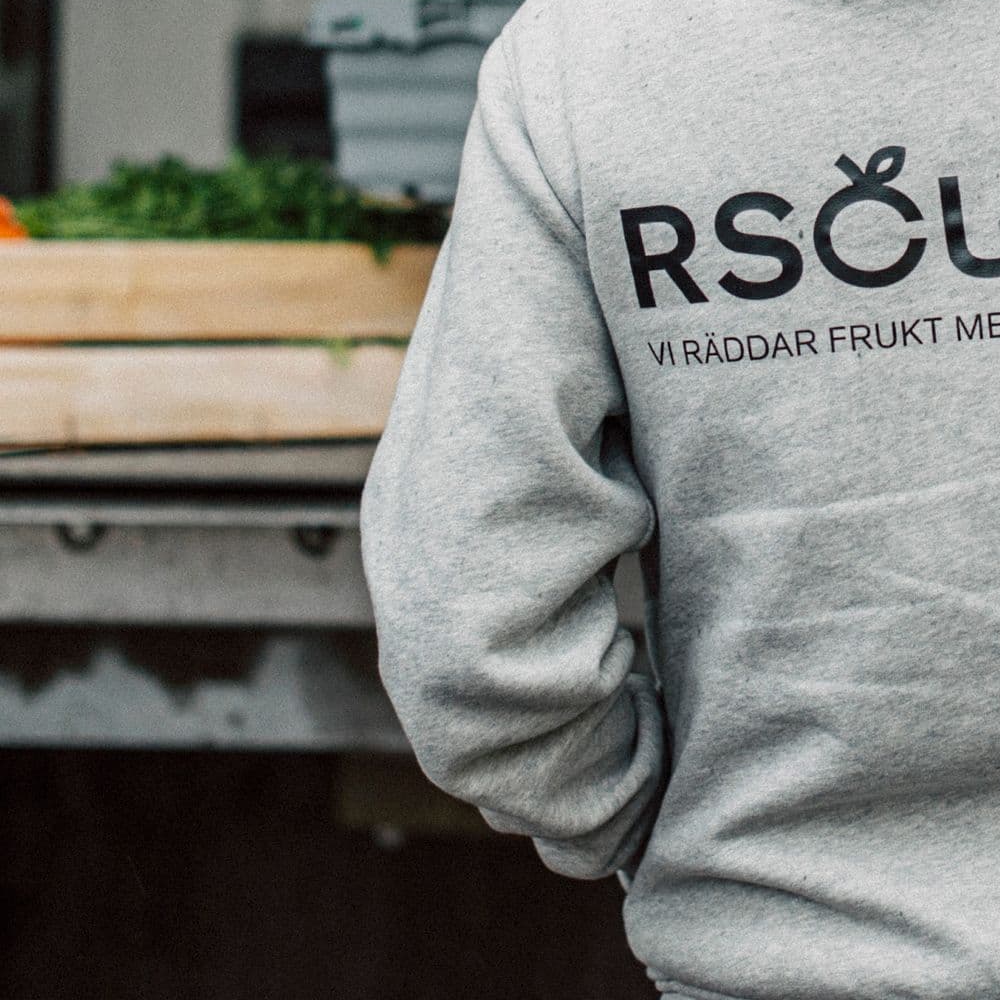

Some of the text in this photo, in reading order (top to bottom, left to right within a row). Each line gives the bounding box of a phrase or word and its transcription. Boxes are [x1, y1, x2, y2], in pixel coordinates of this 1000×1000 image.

[647, 340, 676, 367] VI
[682, 328, 818, 367] RÄDDAR
[828, 316, 943, 354] FRUKT
